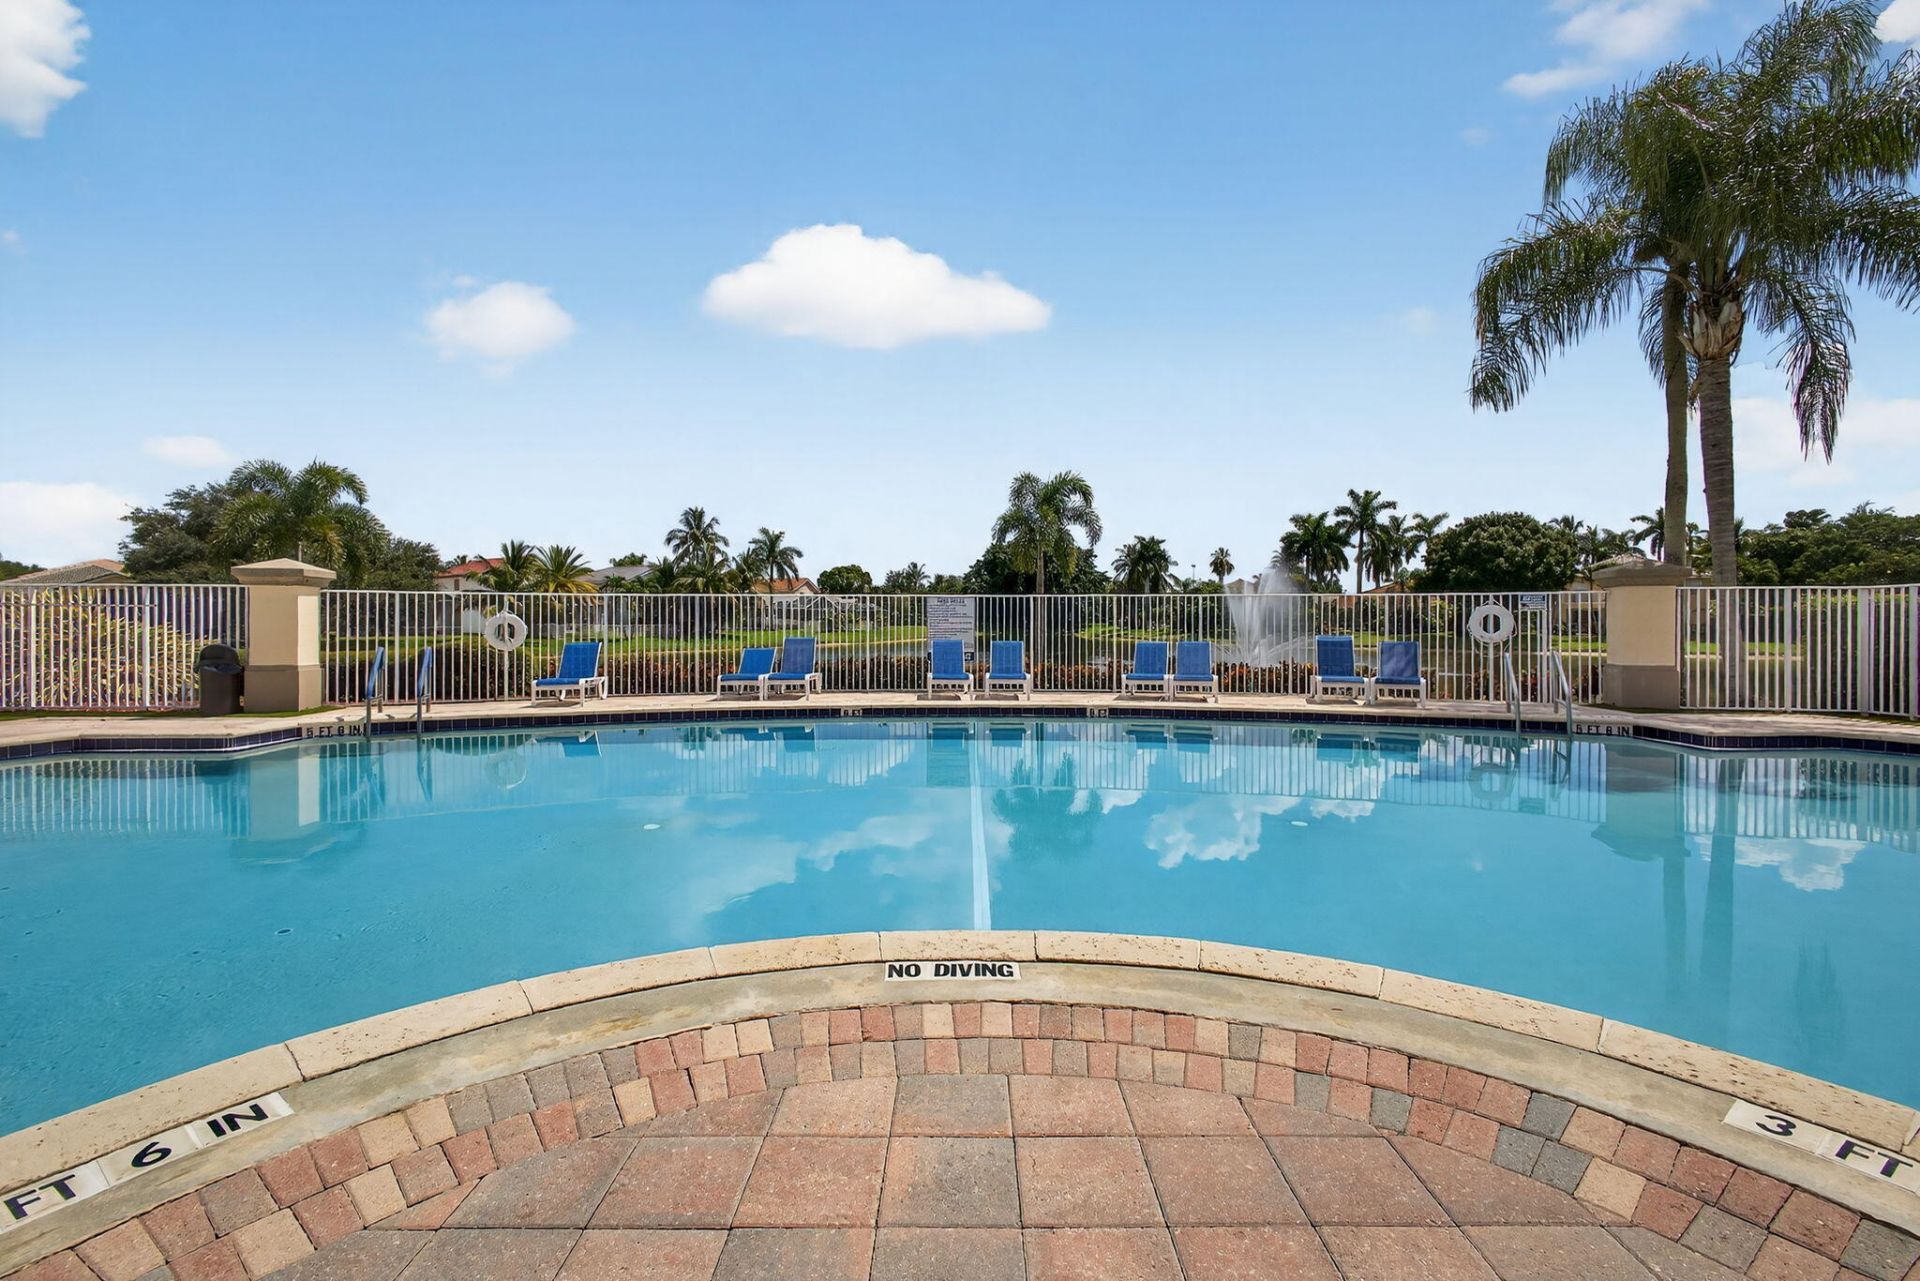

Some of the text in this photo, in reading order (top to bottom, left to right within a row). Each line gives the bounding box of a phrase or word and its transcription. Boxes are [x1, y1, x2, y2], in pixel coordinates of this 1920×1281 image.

[888, 963, 1014, 978] NO DIVING
[4, 1103, 269, 1220] FT 6 IN
[1756, 1114, 1913, 1178] 3 FT
